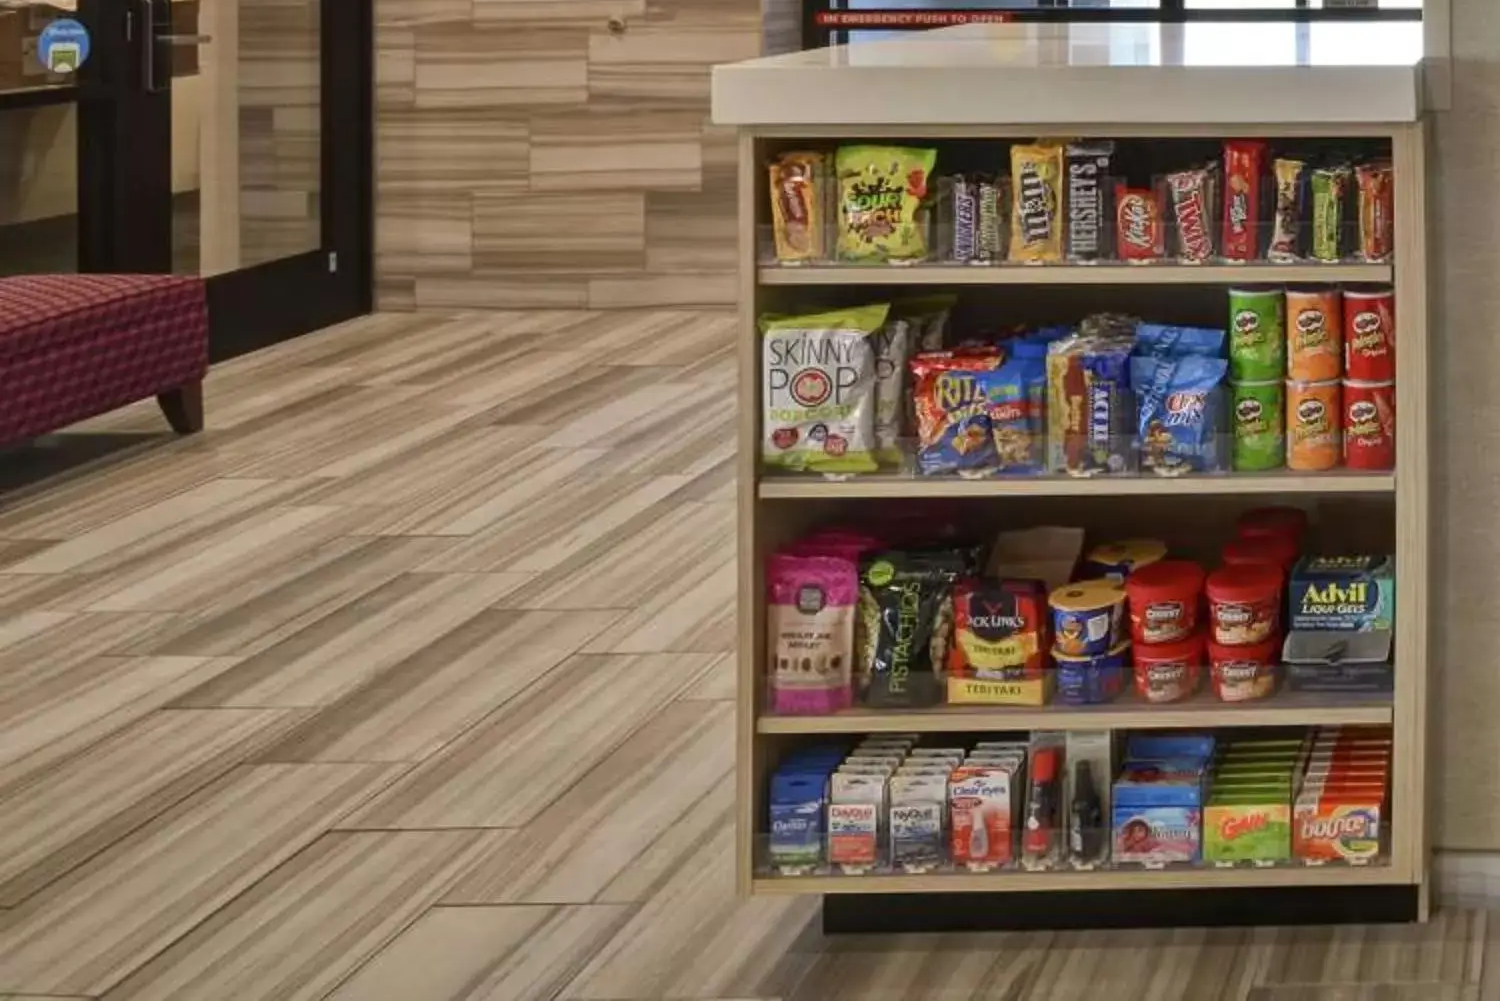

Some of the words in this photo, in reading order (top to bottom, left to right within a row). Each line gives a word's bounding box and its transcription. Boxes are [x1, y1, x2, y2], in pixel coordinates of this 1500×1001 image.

[823, 14, 840, 24] IN
[915, 14, 948, 24] PUSH
[951, 14, 967, 23] TO
[1069, 162, 1097, 252] HERSHEY'S
[769, 335, 857, 366] SKINNY
[769, 366, 858, 407] POP
[1302, 582, 1366, 603] Advil
[889, 582, 921, 694] PISTACHIOS
[966, 684, 1022, 696] TERIYAKI
